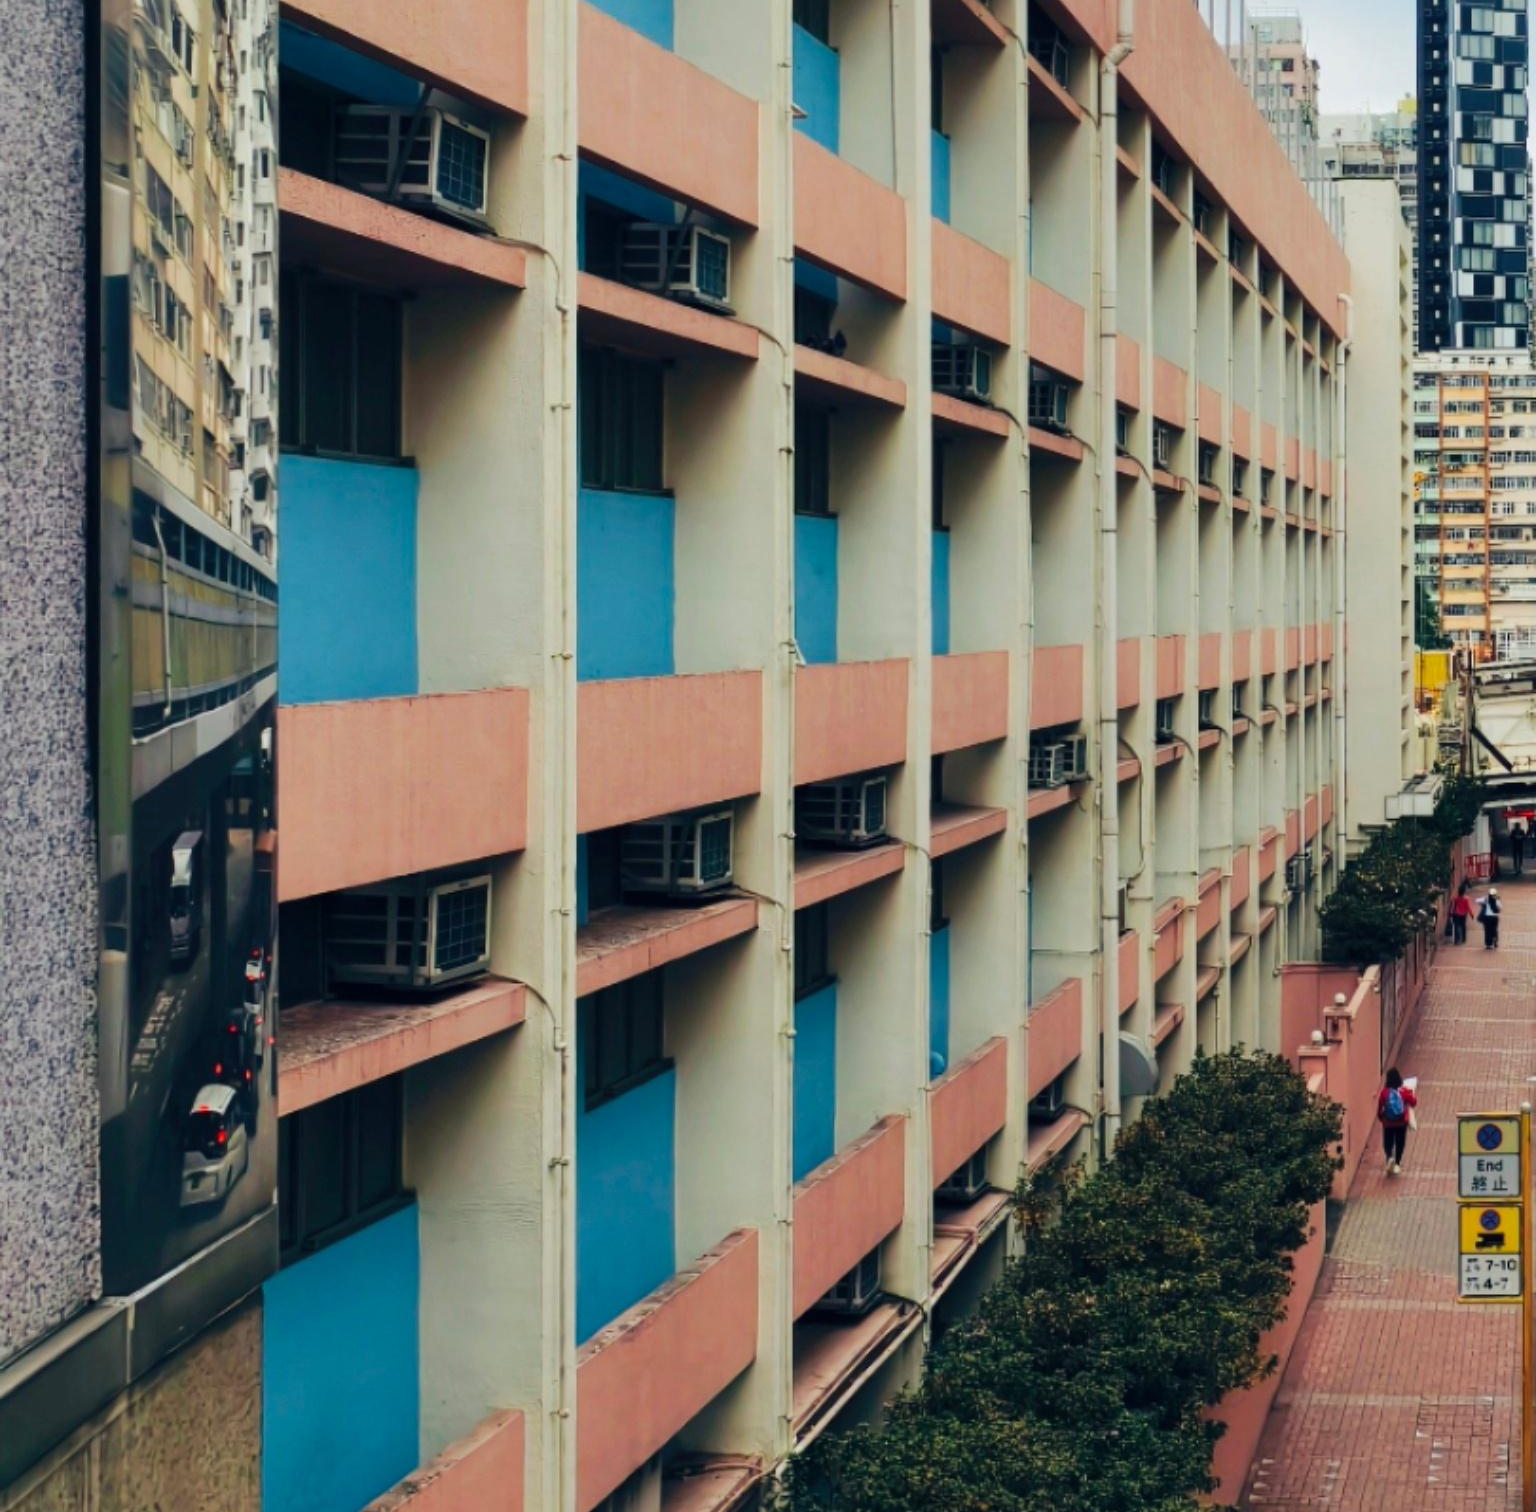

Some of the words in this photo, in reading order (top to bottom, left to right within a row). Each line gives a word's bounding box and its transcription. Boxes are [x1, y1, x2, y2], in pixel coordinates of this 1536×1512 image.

[1477, 1159, 1503, 1172] End
[1471, 1175, 1508, 1192] 終止
[1485, 1259, 1517, 1271] 7-10
[1483, 1277, 1509, 1290] 4-7
